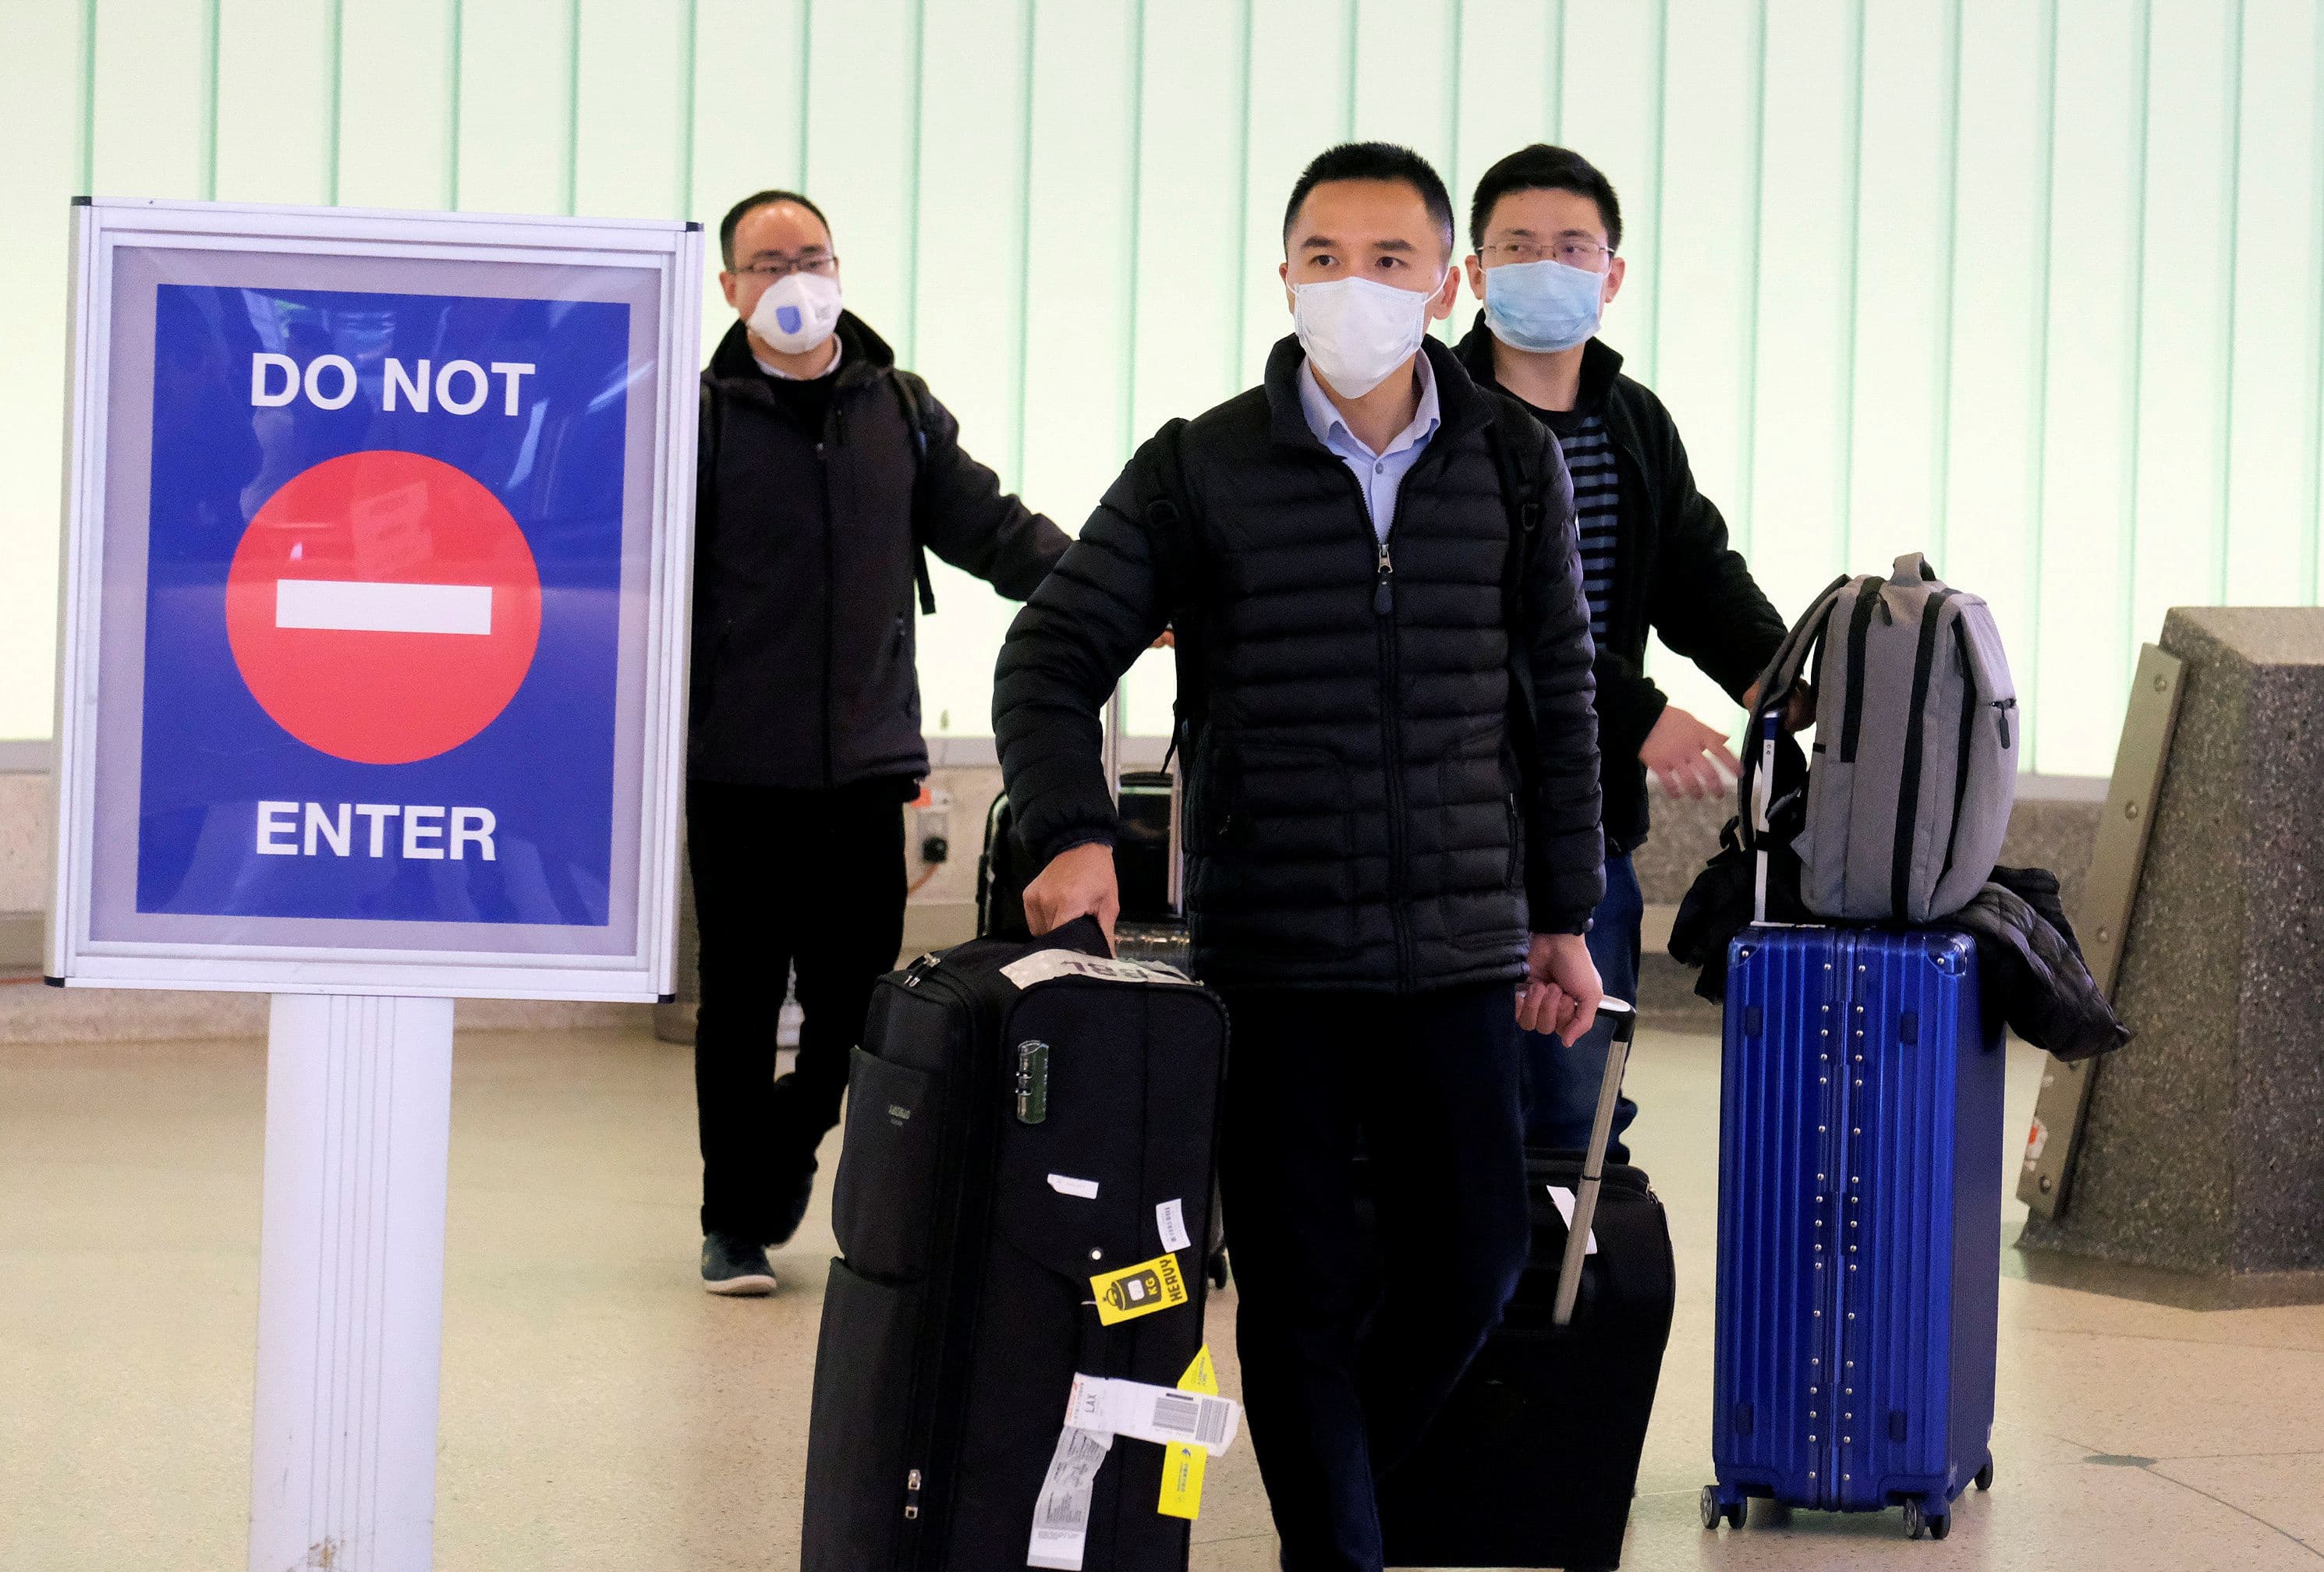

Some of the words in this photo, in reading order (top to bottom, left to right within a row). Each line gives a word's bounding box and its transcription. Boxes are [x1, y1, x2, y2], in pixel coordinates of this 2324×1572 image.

[250, 352, 359, 412] DO
[382, 357, 537, 417] NOT
[255, 799, 498, 862] ENTER
[1145, 1276, 1158, 1295] KG
[1159, 1259, 1183, 1302] HEAVY
[1084, 1393, 1097, 1413] LAX
